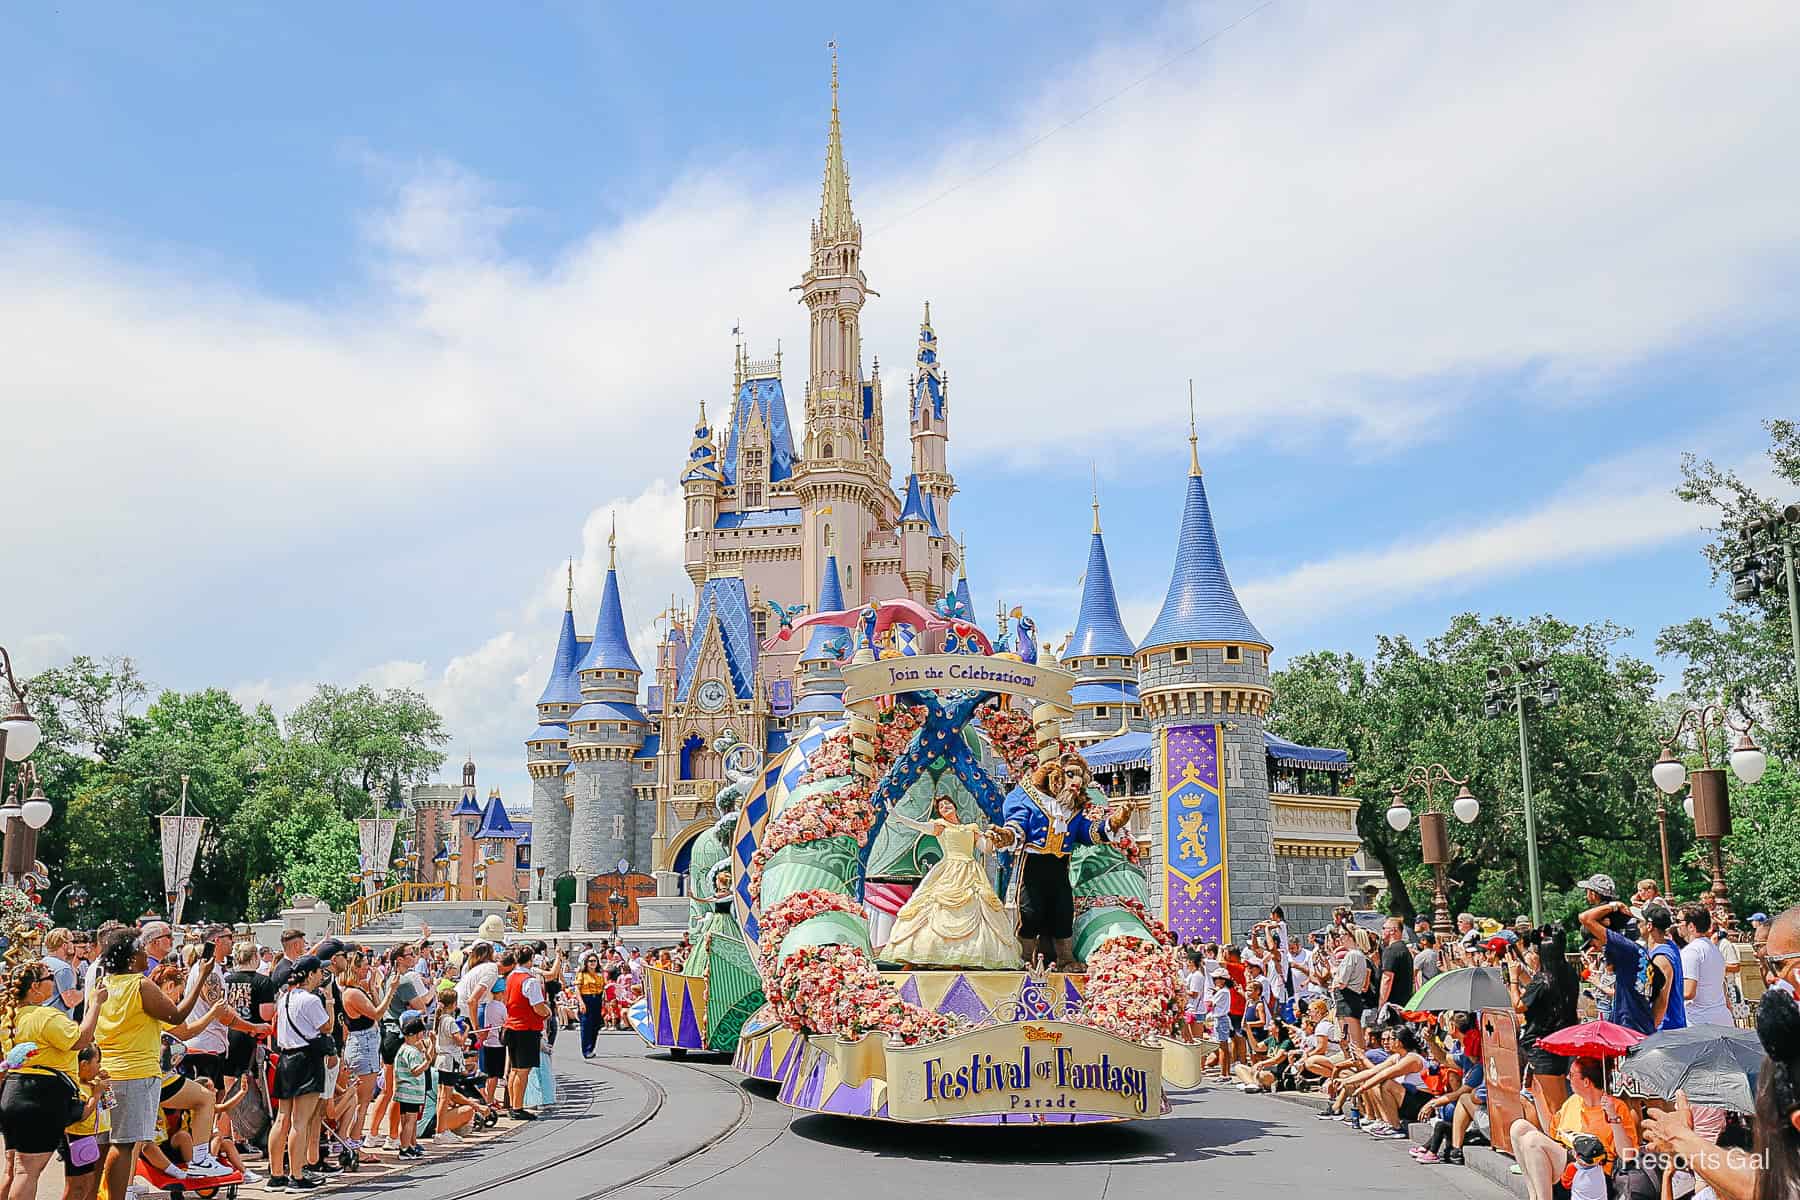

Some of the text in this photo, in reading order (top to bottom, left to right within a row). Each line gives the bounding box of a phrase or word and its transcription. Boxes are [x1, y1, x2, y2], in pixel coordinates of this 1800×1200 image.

[888, 664, 1037, 688] Join the Celebration!
[1022, 1025, 1063, 1045] Disney
[923, 1045, 1031, 1103] Festival
[1053, 1047, 1148, 1114] Fantasy
[1010, 1094, 1077, 1109] Parade
